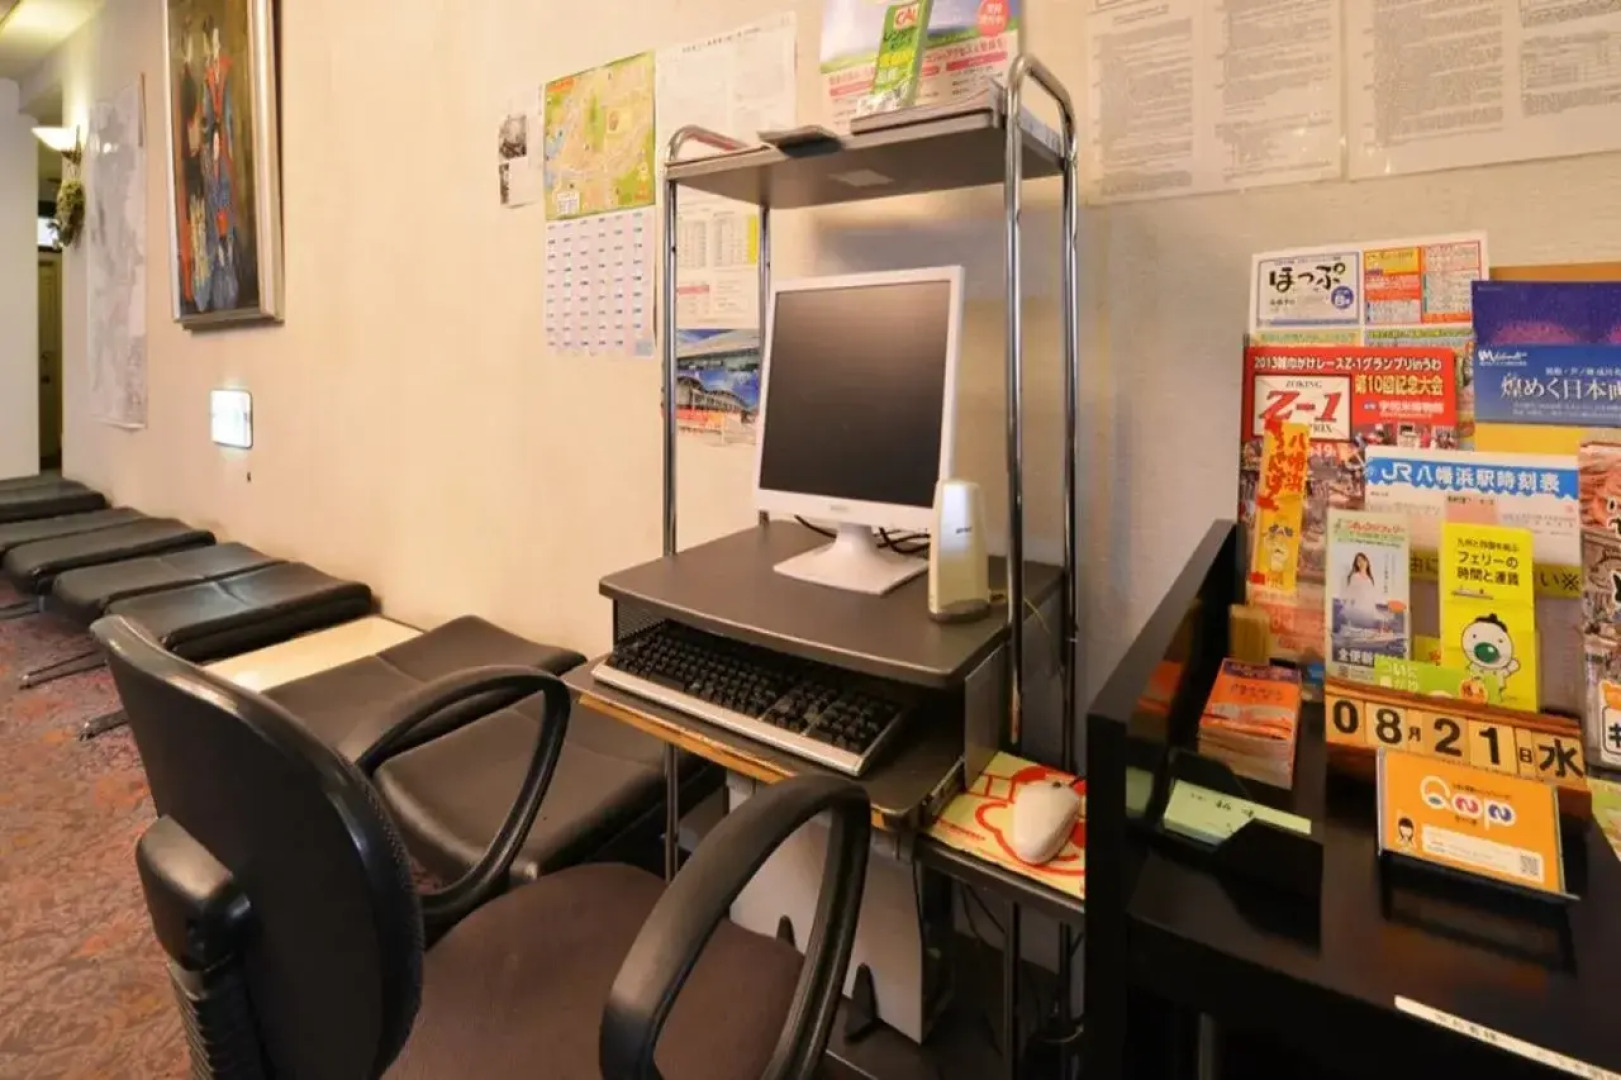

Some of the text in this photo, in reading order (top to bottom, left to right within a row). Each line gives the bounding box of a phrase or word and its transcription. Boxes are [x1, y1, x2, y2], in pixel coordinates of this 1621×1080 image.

[1269, 262, 1346, 293] ほっぷ
[1355, 374, 1443, 396] 第10回記念大会
[1258, 390, 1342, 422] Z-1
[1381, 461, 1560, 492] JR八幡浜駅時刻表
[1458, 551, 1519, 569] フェリーの
